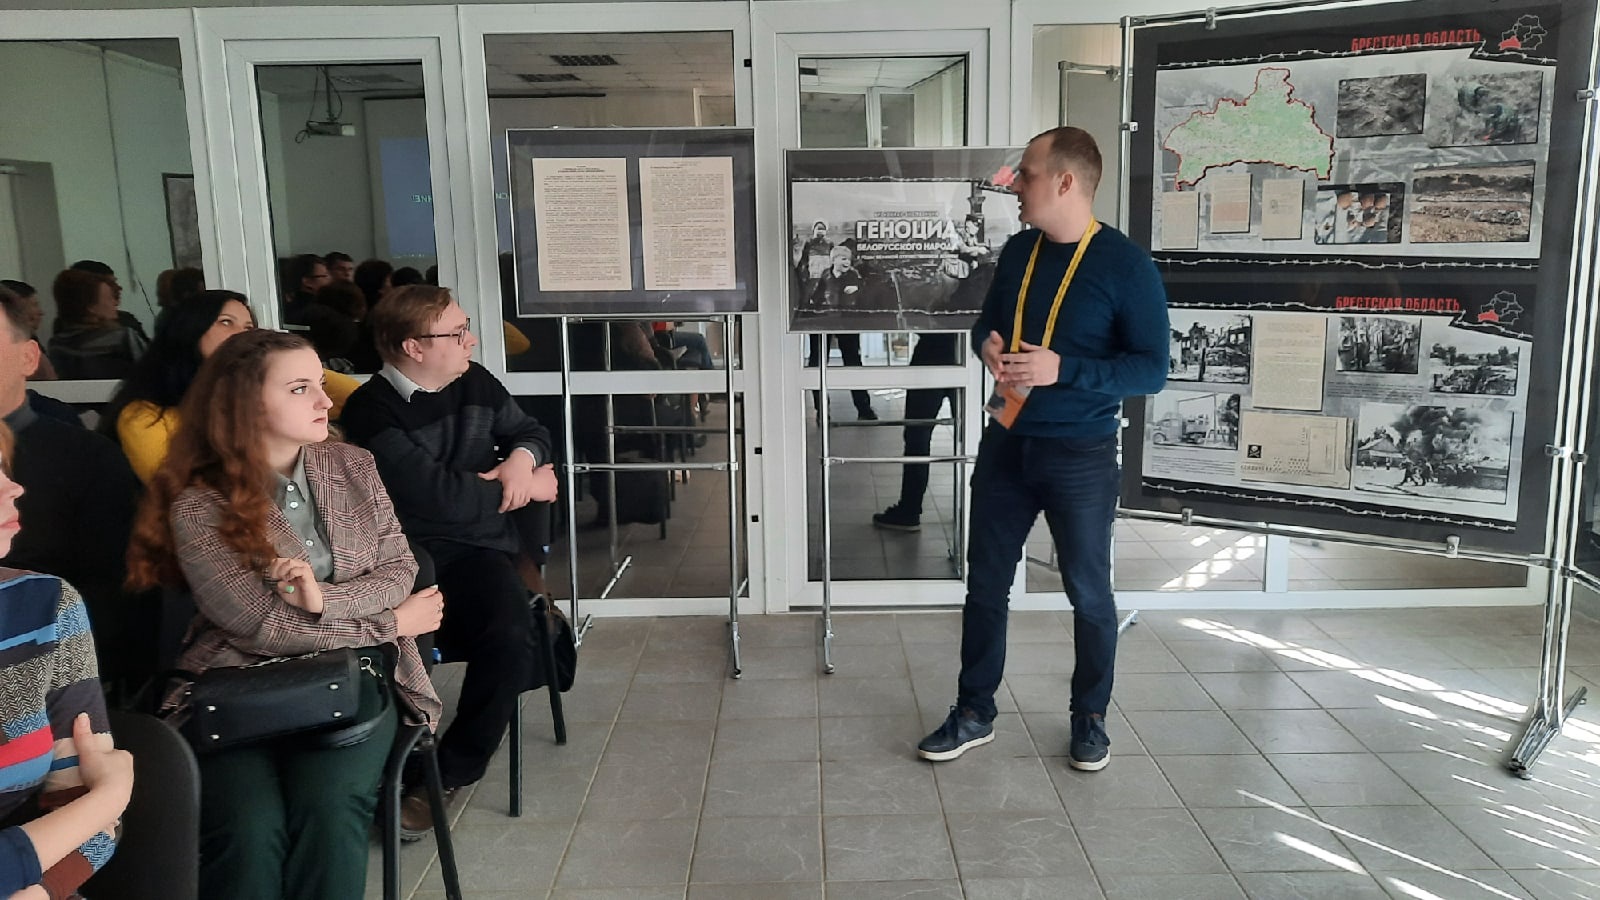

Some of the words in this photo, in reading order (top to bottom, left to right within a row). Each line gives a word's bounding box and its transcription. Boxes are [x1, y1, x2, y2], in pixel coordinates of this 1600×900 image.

[1351, 33, 1420, 52] БРЕСТСКАЯ
[1424, 28, 1480, 44] ОБЛАСТЬ
[857, 220, 959, 240] ГЕНОЦИД
[857, 242, 922, 251] БЕЛОРУССКОГО
[1335, 296, 1402, 309] БРЕСТСКАЯ
[1405, 297, 1460, 311] ОБЛАСТЬ
